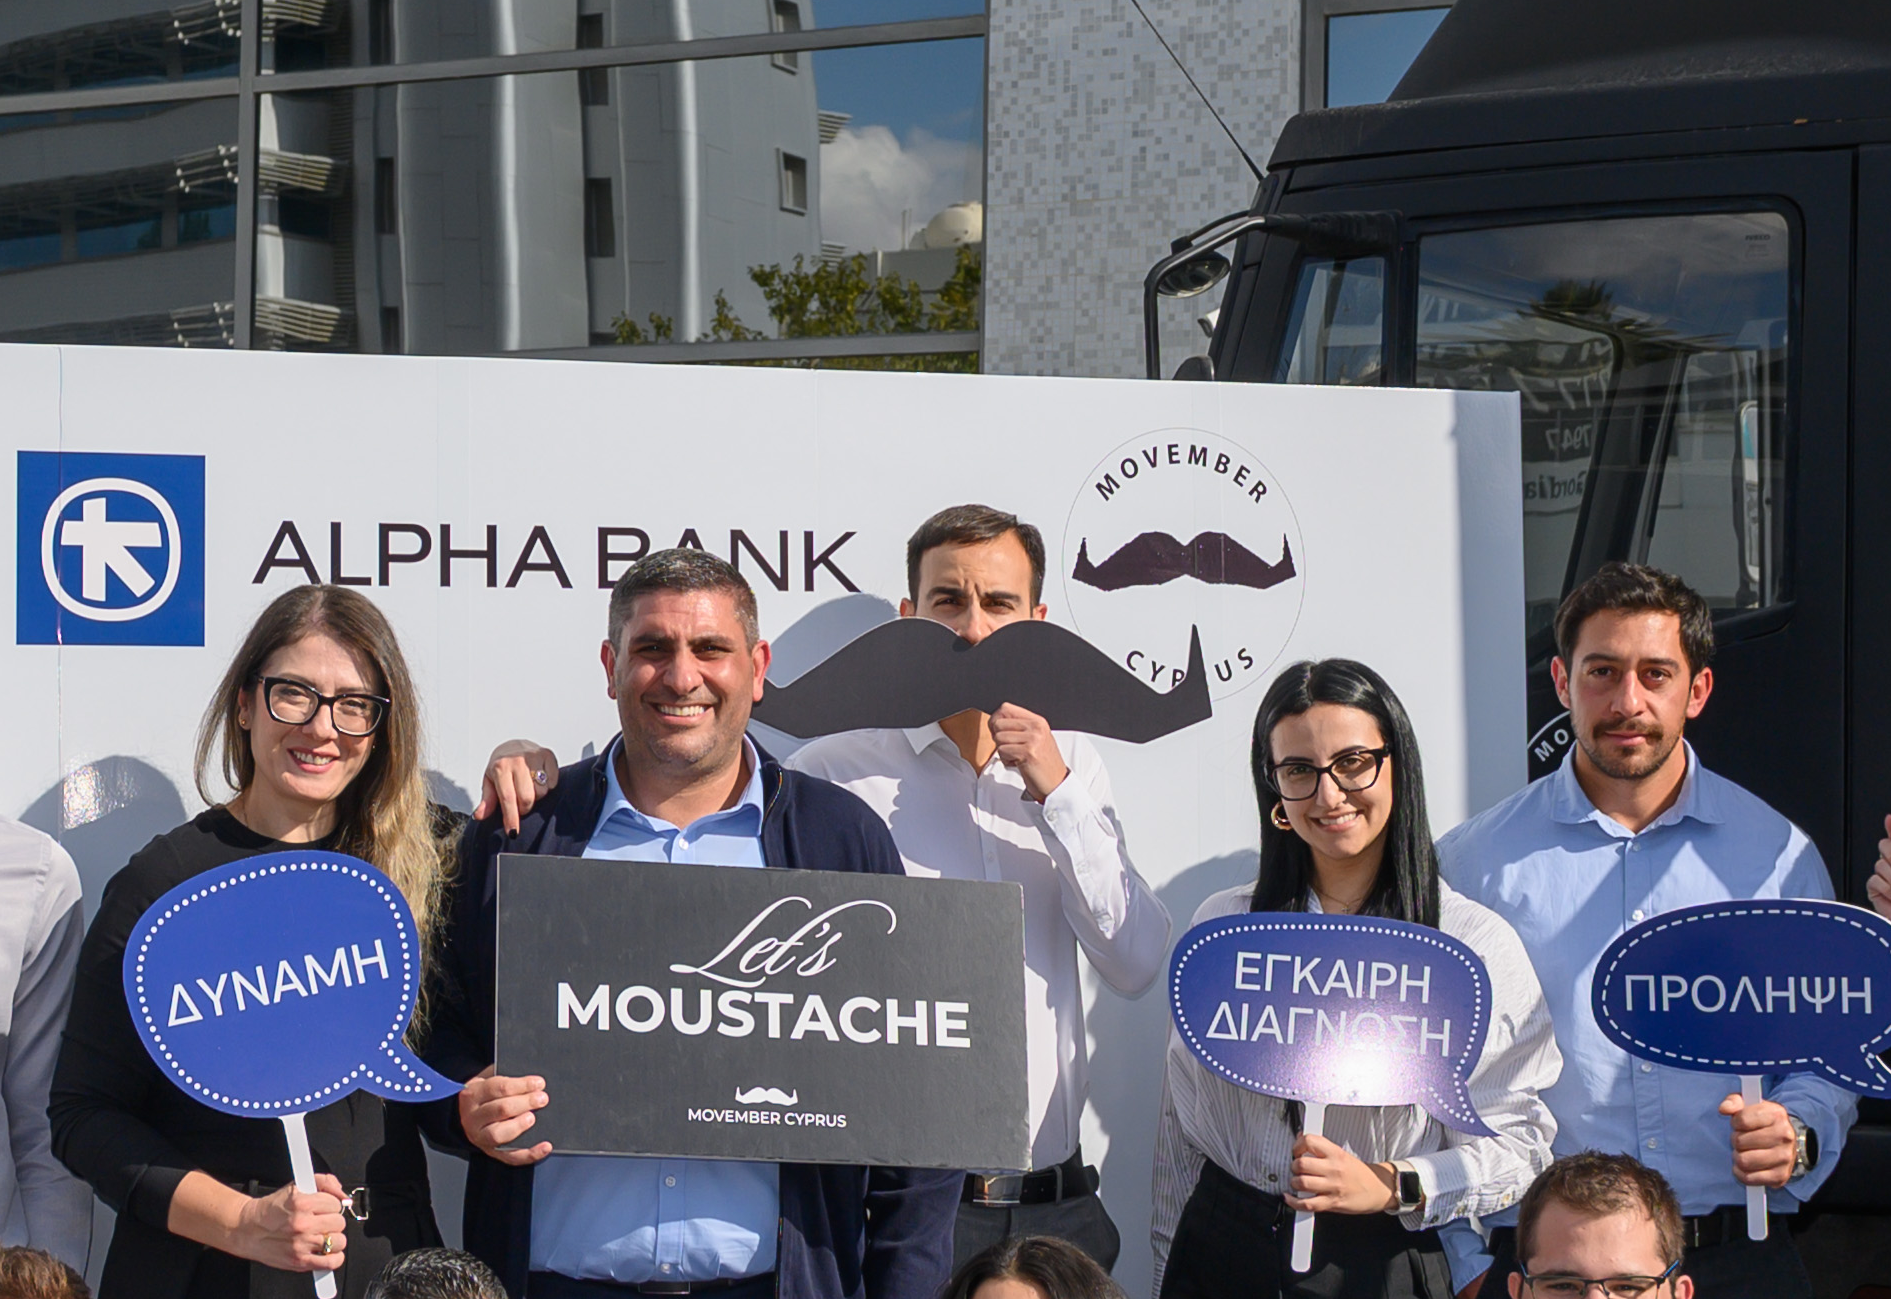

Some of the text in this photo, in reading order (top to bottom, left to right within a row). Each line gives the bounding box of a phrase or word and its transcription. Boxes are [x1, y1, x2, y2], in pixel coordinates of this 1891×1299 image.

[1094, 443, 1268, 504] MOVEMBER
[252, 519, 862, 593] ALPHA BNK
[1126, 647, 1255, 688] CYPUS
[669, 895, 897, 988] Let's
[167, 938, 390, 1028] ΔΥΝΑΜΗ
[1233, 951, 1432, 1004] ΕΓΚΑΙΡΗ
[1625, 974, 1872, 1015] ΠΡΟΛΗΨΗ
[556, 981, 971, 1049] MOUSTACHE
[1205, 999, 1452, 1058] ΔΙΑΓΝΩΣΗ
[687, 1107, 847, 1129] MOVEMBER CYPRUS
